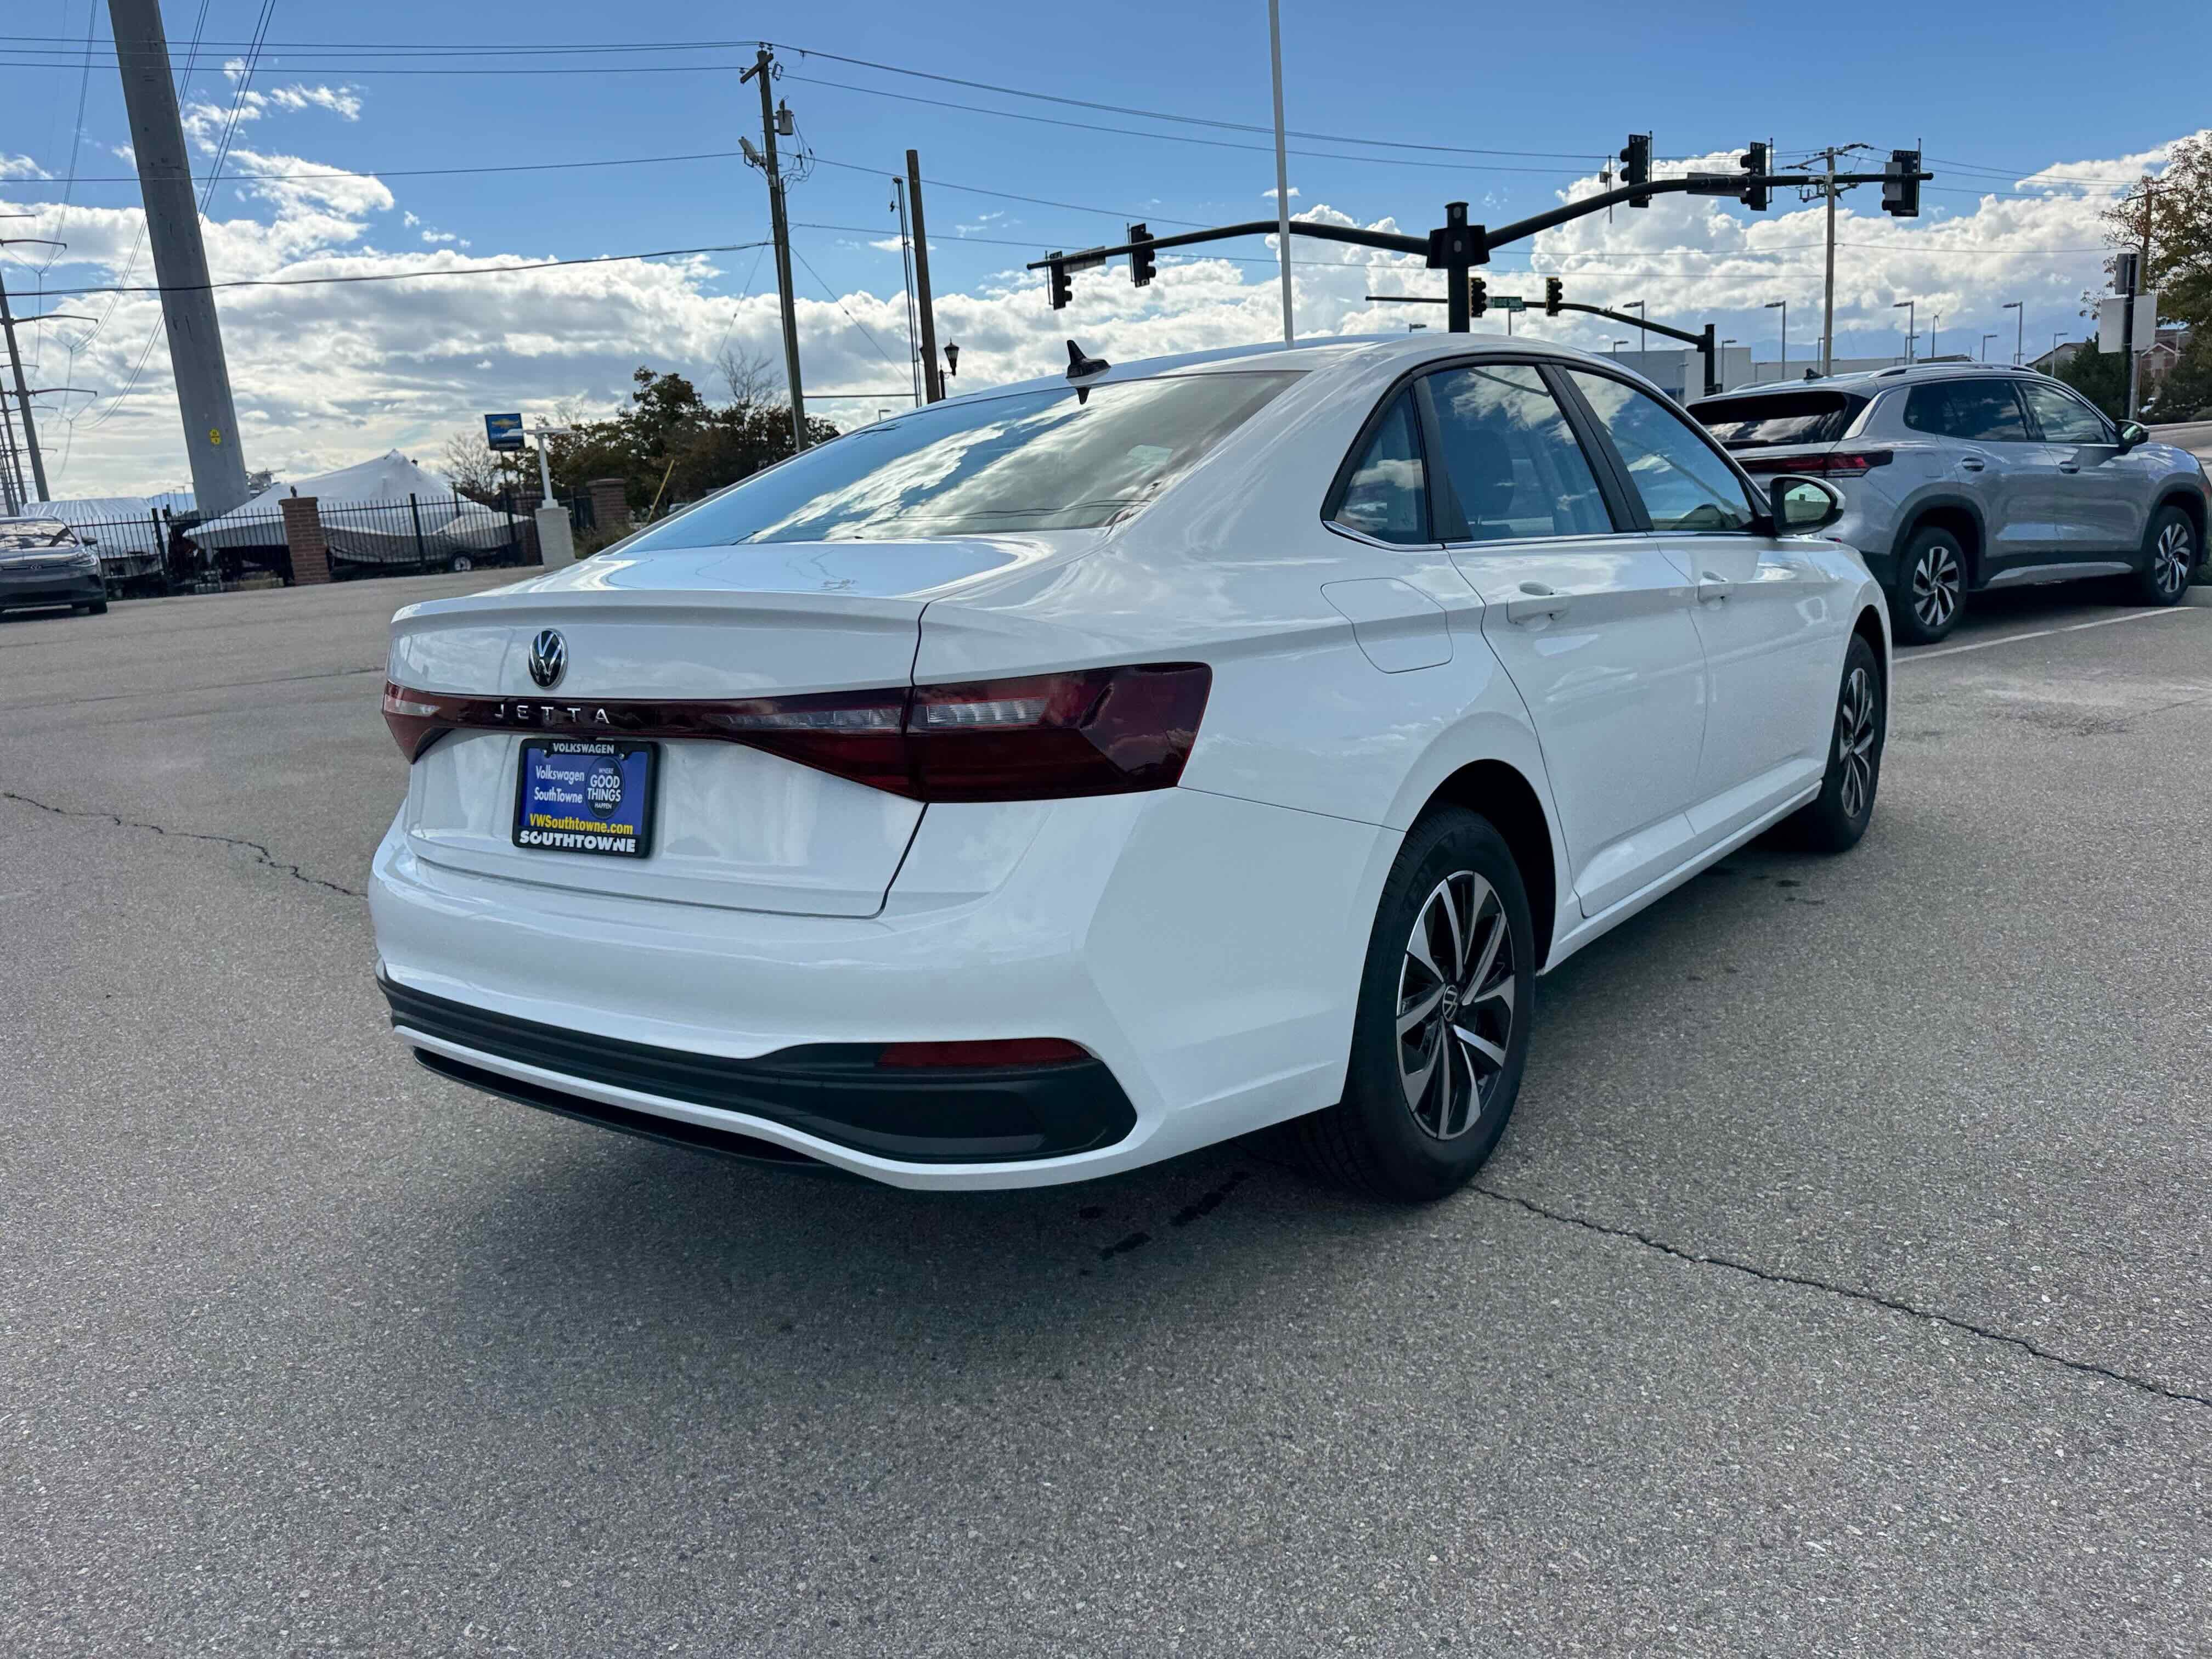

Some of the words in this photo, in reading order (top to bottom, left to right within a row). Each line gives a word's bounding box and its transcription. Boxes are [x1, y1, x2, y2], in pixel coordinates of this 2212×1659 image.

[495, 704, 610, 724] JETTA
[553, 743, 614, 754] VOLKSWAGEN
[535, 765, 585, 785] Volkswagen
[590, 775, 620, 788] GOOD
[534, 787, 583, 803] SouthTowne
[588, 788, 621, 802] THINGS
[529, 814, 633, 834] VWSouthtowne.com
[520, 831, 636, 853] SOUTHTOWNE
